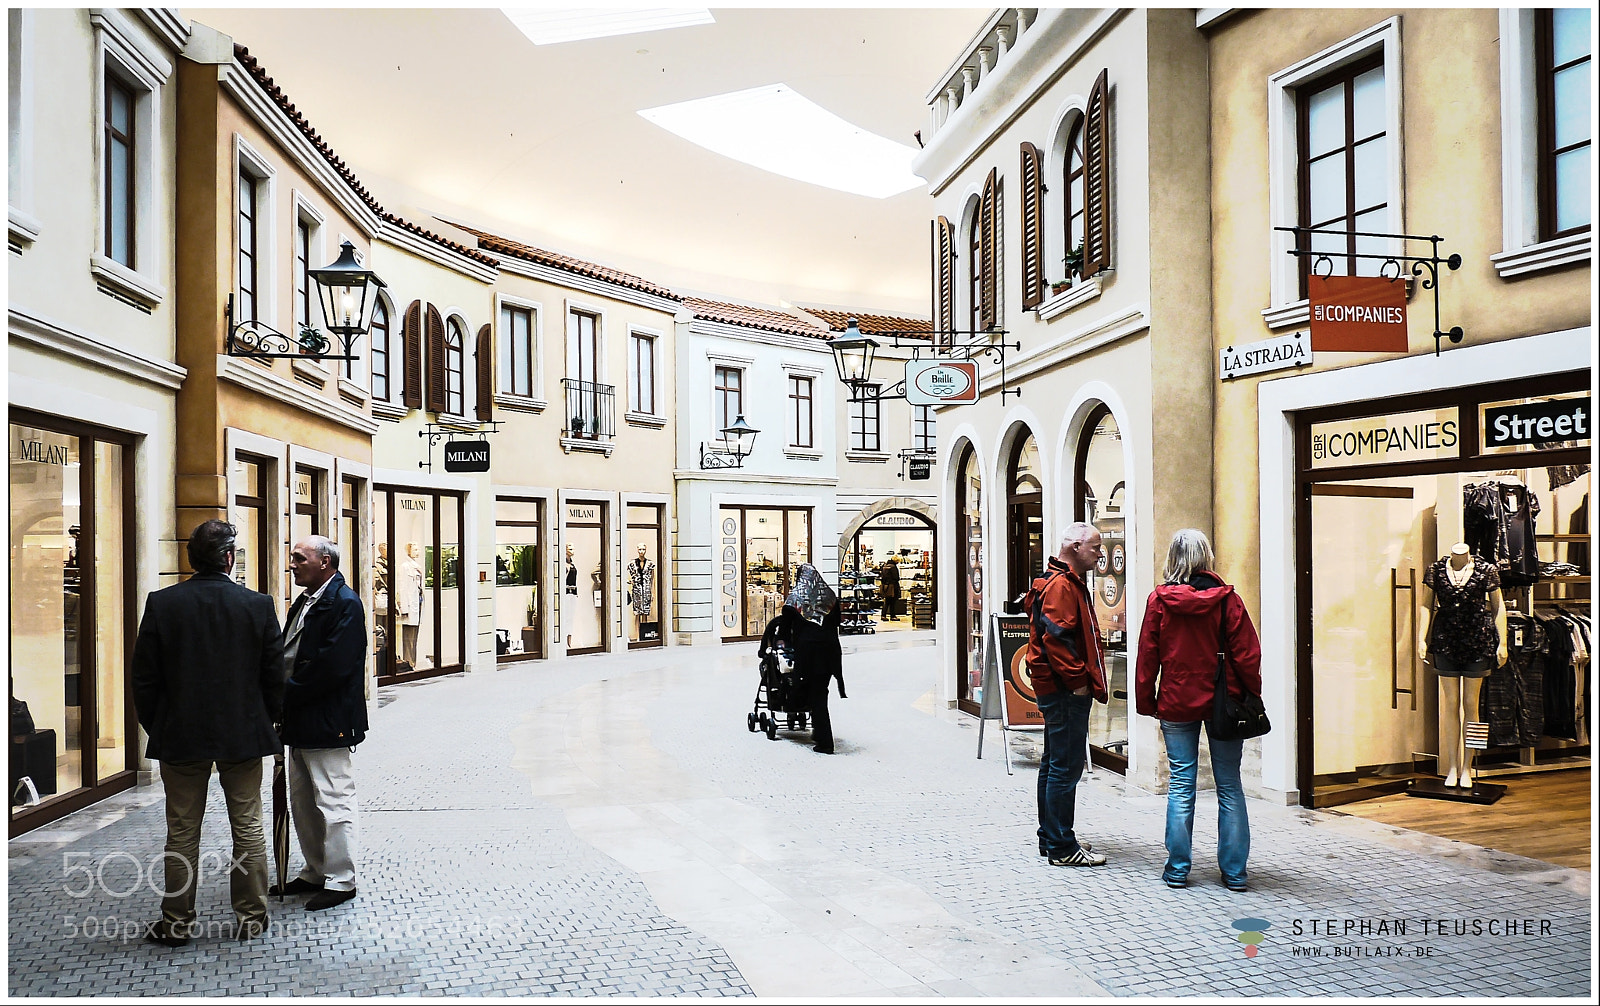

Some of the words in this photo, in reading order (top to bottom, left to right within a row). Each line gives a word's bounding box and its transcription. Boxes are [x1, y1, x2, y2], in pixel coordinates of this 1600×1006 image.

[1326, 305, 1403, 324] COMPANIES
[1223, 354, 1243, 371] LA
[1244, 341, 1305, 367] STRADA
[1493, 407, 1587, 442] Street
[1313, 434, 1323, 460] CBR
[1328, 420, 1458, 458] COMPANIES
[20, 439, 69, 466] MILANI
[447, 451, 487, 462] MILANI
[400, 499, 426, 511] MILANI
[569, 508, 594, 518] MILANI
[876, 516, 915, 525] CLAUDIO
[722, 517, 738, 629] CLAUDIO
